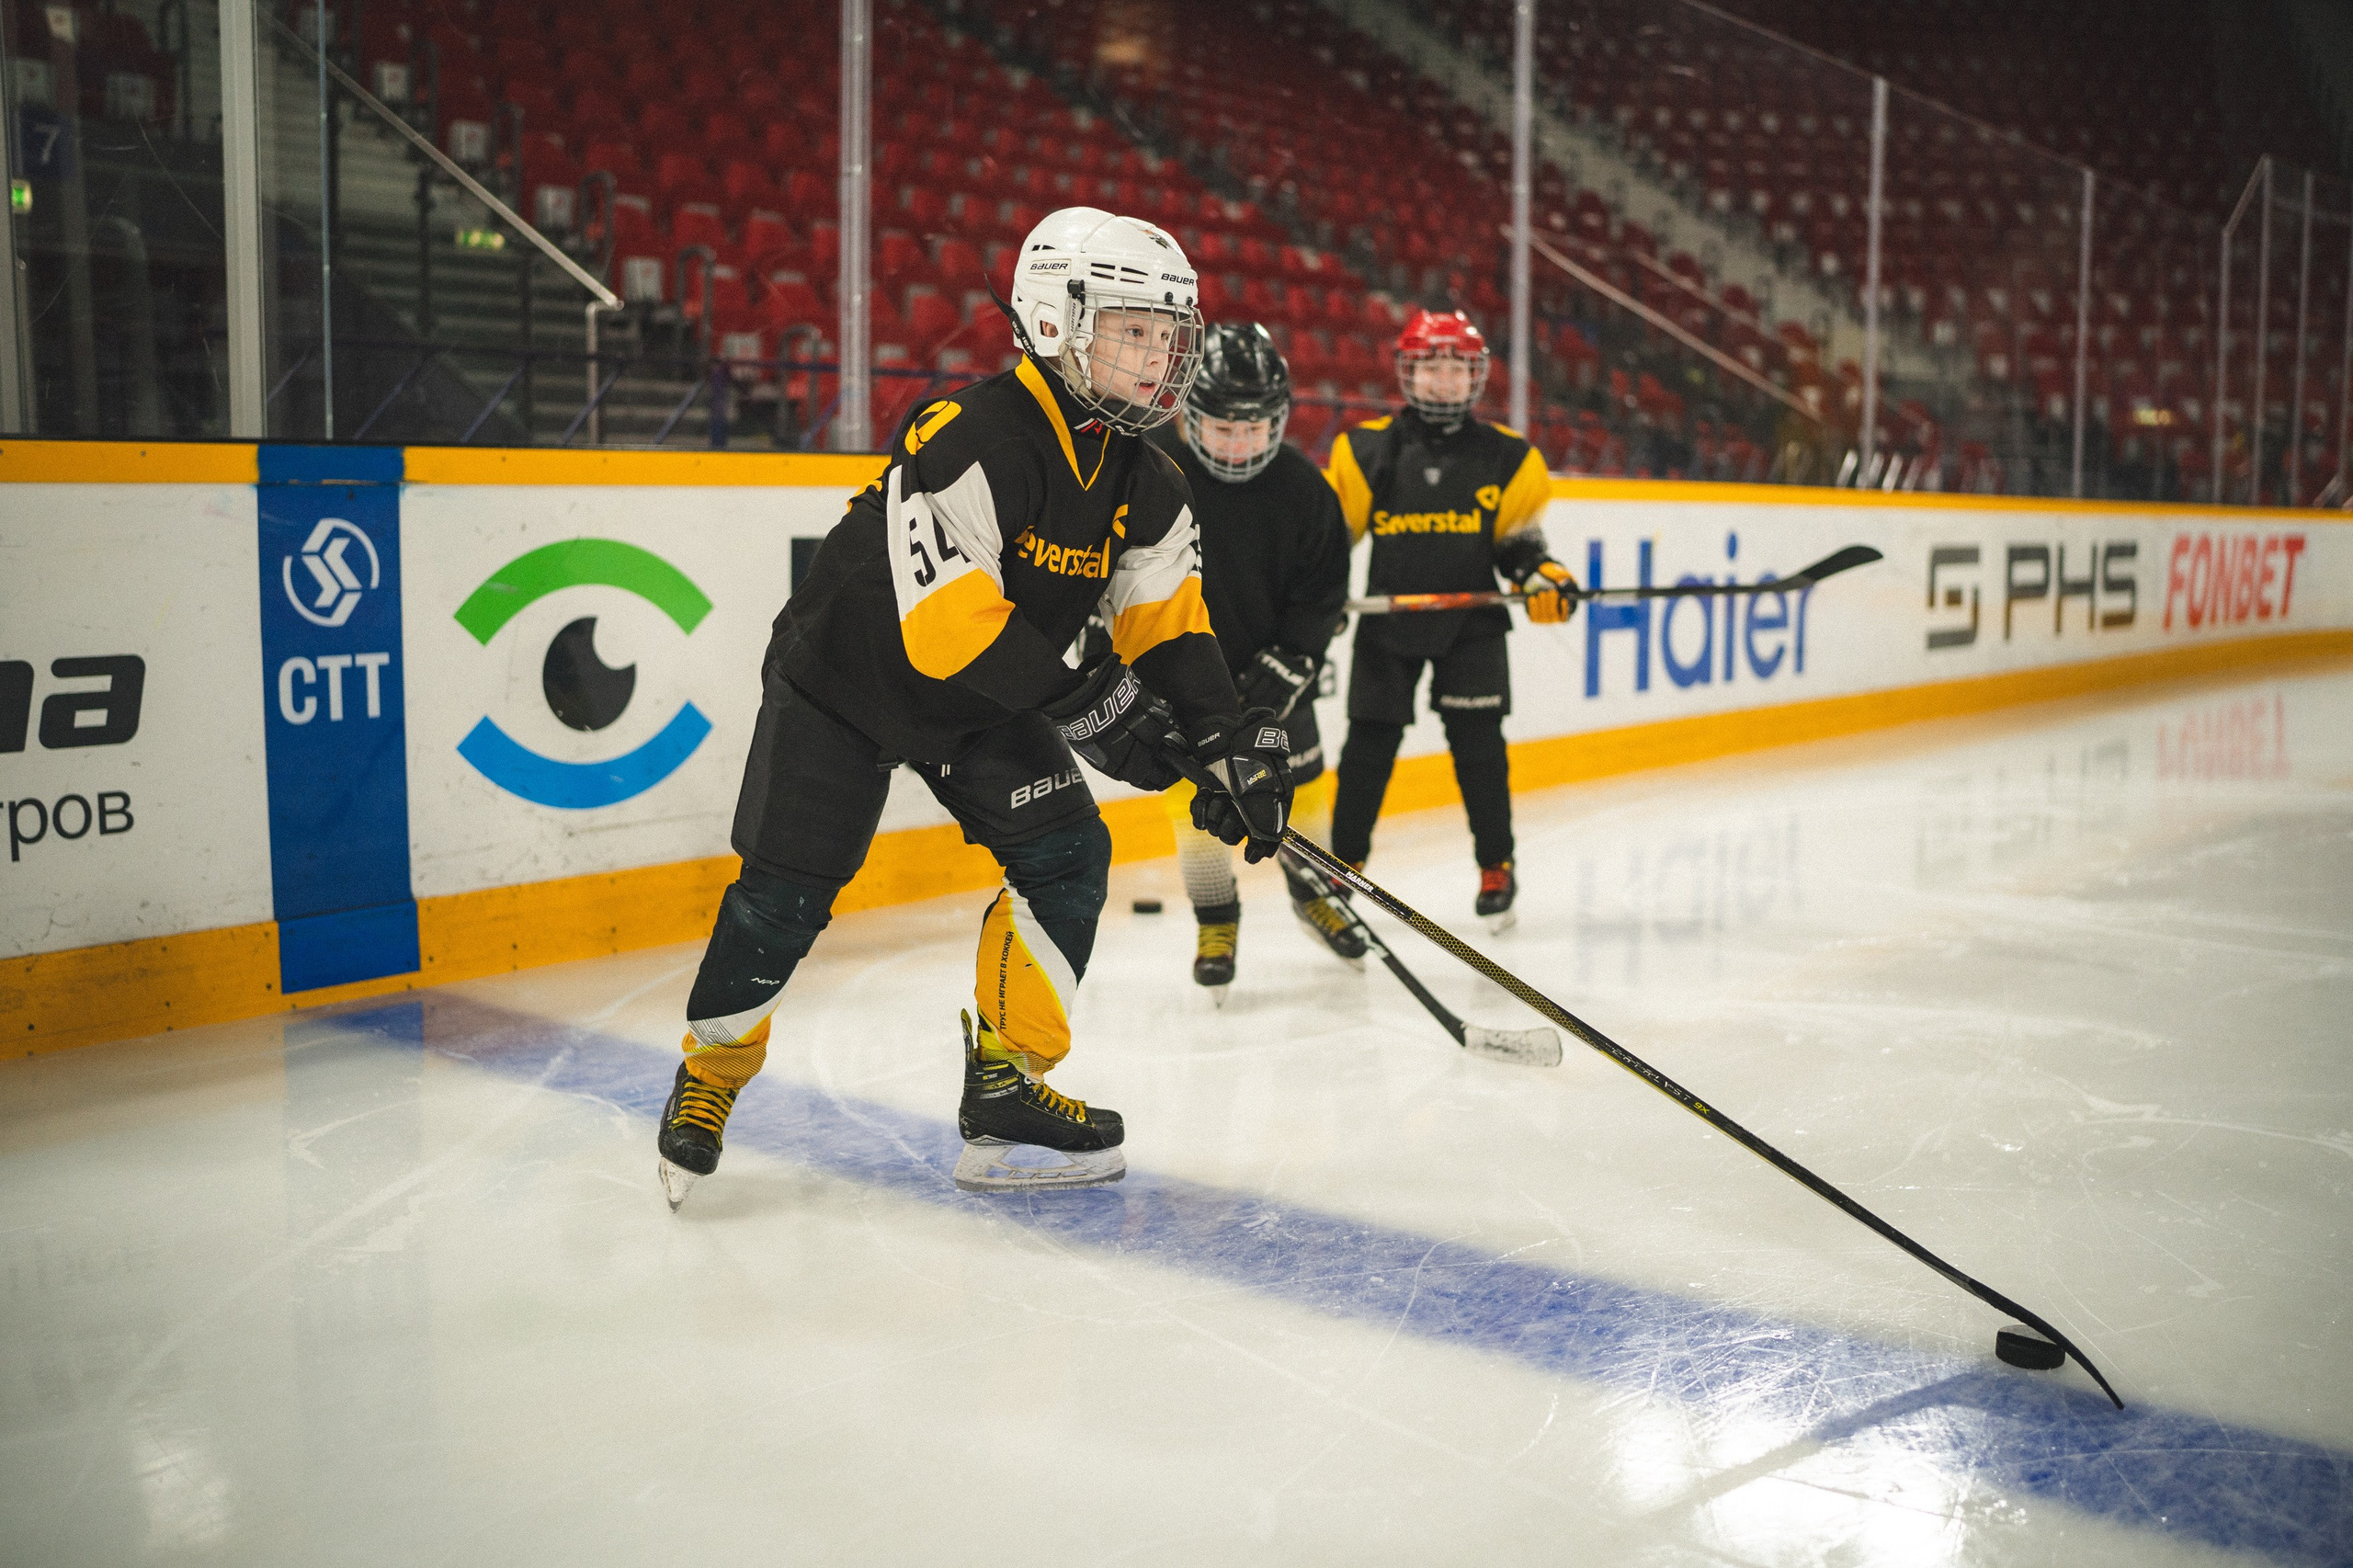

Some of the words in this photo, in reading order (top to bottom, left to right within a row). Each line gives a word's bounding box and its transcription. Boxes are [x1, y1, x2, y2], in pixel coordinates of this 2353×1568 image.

[1161, 273, 1195, 286] BAUER
[1373, 508, 1482, 535] Severstal
[2005, 540, 2137, 639] PHS
[2163, 534, 2305, 631] FONBET
[1586, 532, 1815, 699] Haier
[1011, 767, 1086, 809] BAUE
[0, 790, 134, 862] ров
[1345, 870, 1374, 893] MARNER
[1001, 931, 1014, 962] ХОККЕЙ
[998, 969, 1006, 998] ИГРАЕТ
[999, 1000, 1006, 1010] НЕ
[1693, 1101, 1711, 1115] 9X
